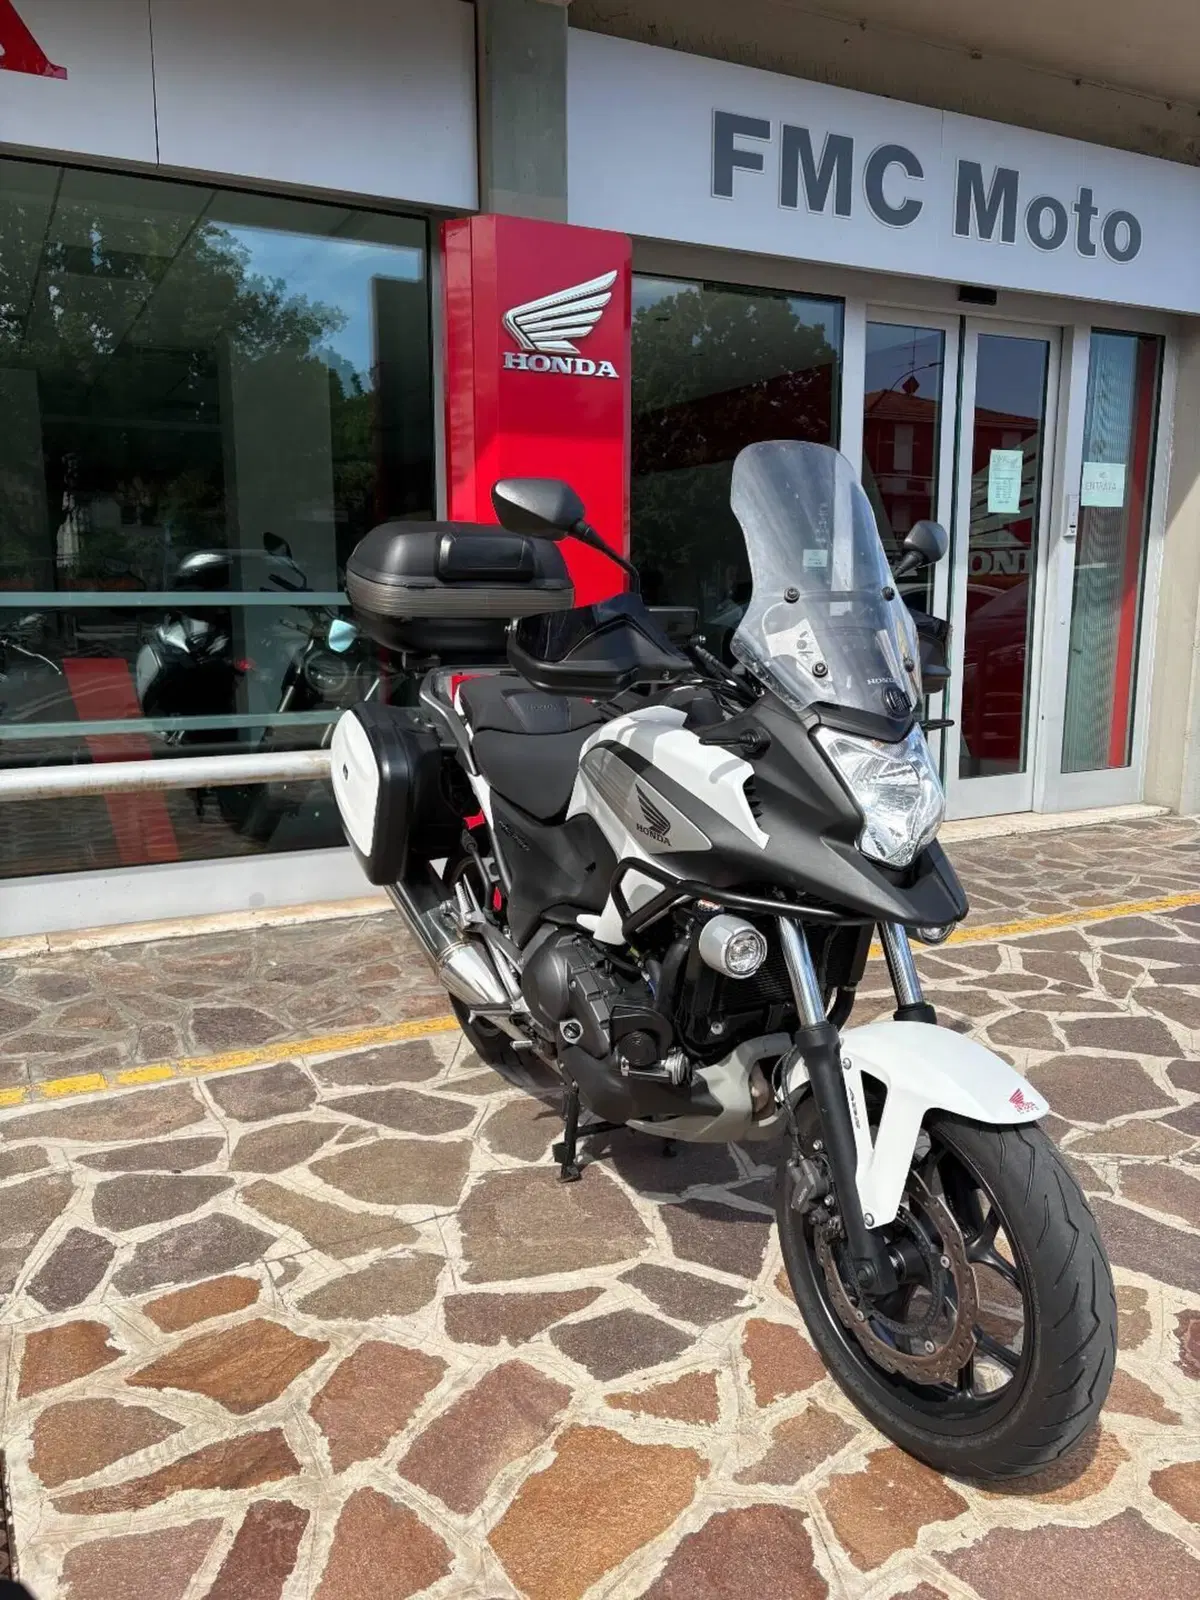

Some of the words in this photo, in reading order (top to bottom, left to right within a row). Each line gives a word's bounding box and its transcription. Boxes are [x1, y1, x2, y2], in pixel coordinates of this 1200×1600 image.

[711, 108, 925, 229] FMC
[952, 157, 1143, 264] Moto
[503, 351, 619, 378] HONDA
[636, 823, 671, 847] HONDA
